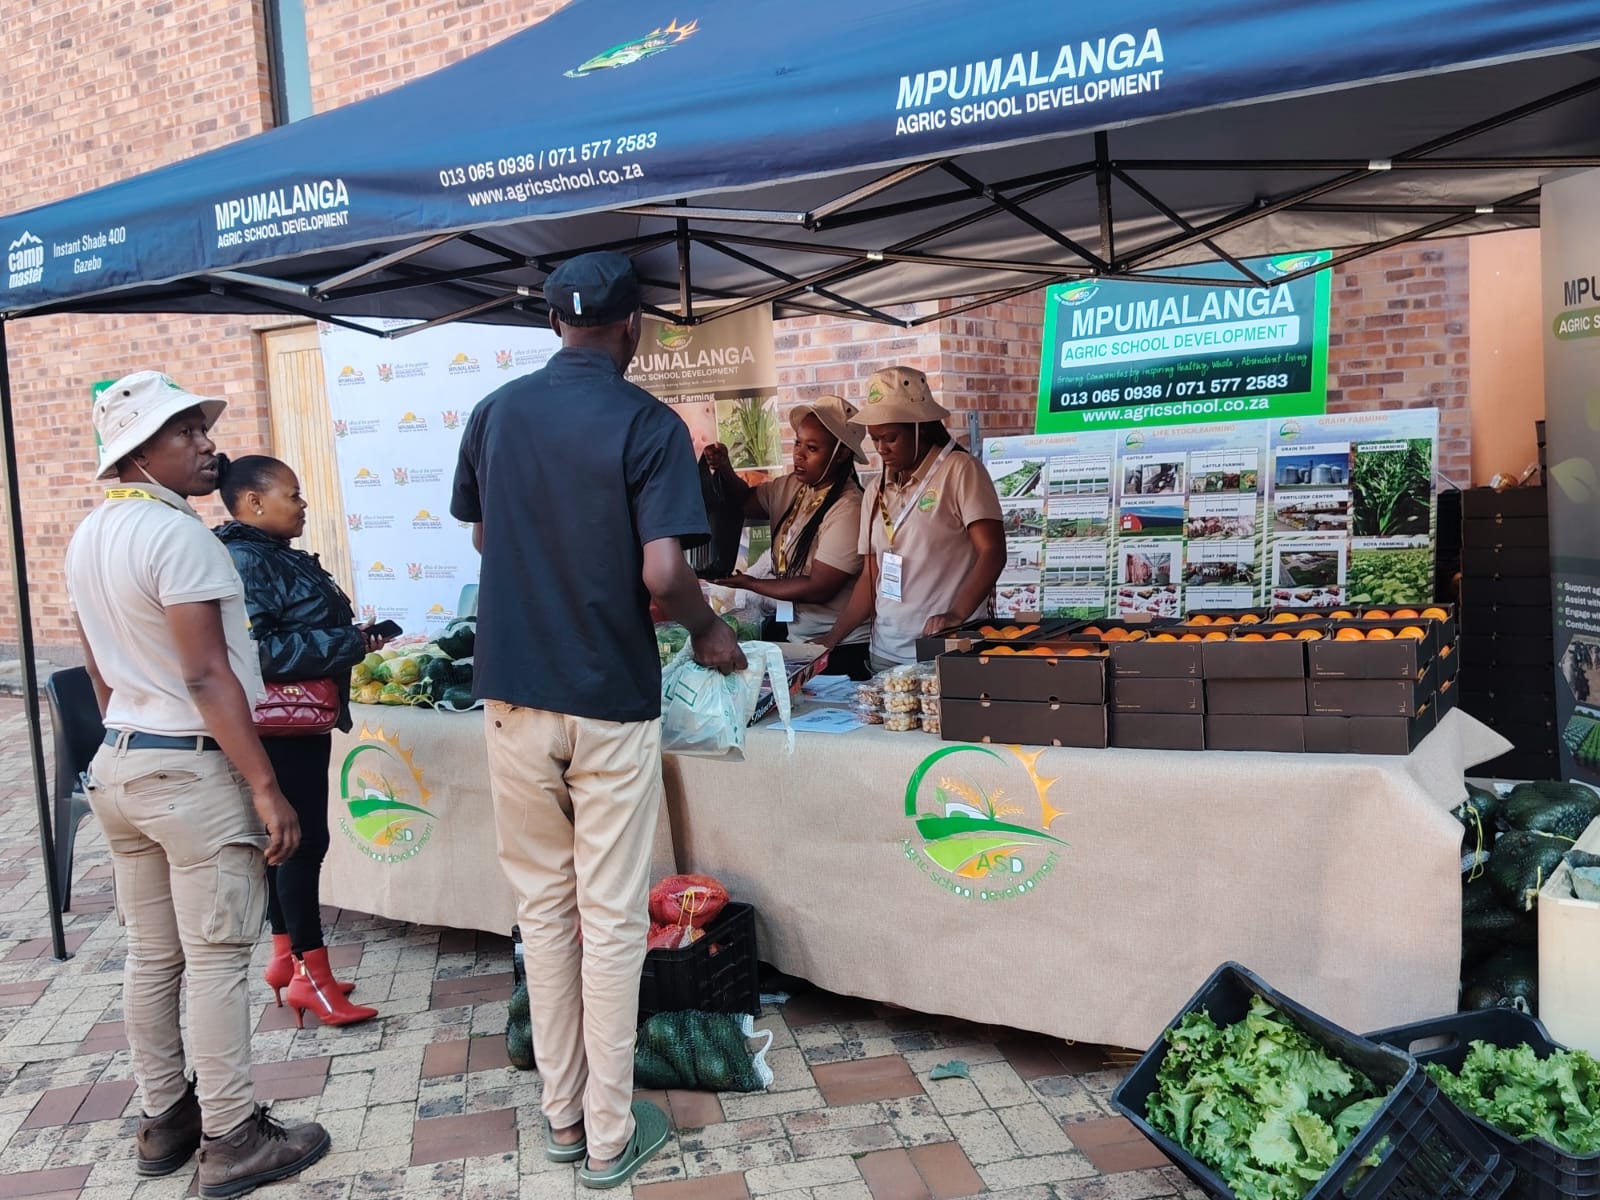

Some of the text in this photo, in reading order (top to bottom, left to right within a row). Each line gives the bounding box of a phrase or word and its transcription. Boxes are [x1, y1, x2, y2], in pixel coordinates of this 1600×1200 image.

[896, 28, 1164, 110] MPUMALANGA
[896, 70, 1163, 135] AGRIC SCHOOL DEVELOPMENT
[439, 132, 657, 187] 013 065 0936 / 071 577 2583
[468, 162, 644, 207] www.agricschool.co.za
[214, 178, 349, 230] MPUMALANGA
[53, 226, 126, 257] Instant Shade 400
[217, 211, 349, 248] AGRIC SCHOOL DEVELOPMENT
[8, 243, 44, 272] camp
[74, 256, 102, 274] Gazebo
[9, 267, 44, 289] master
[1071, 283, 1295, 337] MPUMALANGA
[1559, 316, 1590, 334] AGRIC
[1064, 324, 1287, 361] AGRIC SCHOOL DEVELOPMENT
[625, 346, 755, 374] PUMALANGA
[648, 371, 680, 381] SCHOOL
[682, 366, 739, 378] DEVELOPMENT
[681, 392, 715, 402] Farming
[1061, 373, 1288, 407] 013 065 0936 / 071 577 2583
[1082, 396, 1269, 423] www.agricschool.co.za
[1564, 582, 1591, 594] Support
[1565, 595, 1586, 605] Assist
[1565, 607, 1591, 619] Engage
[385, 827, 413, 841] ASD
[976, 853, 1024, 873] ASD
[929, 870, 974, 900] school
